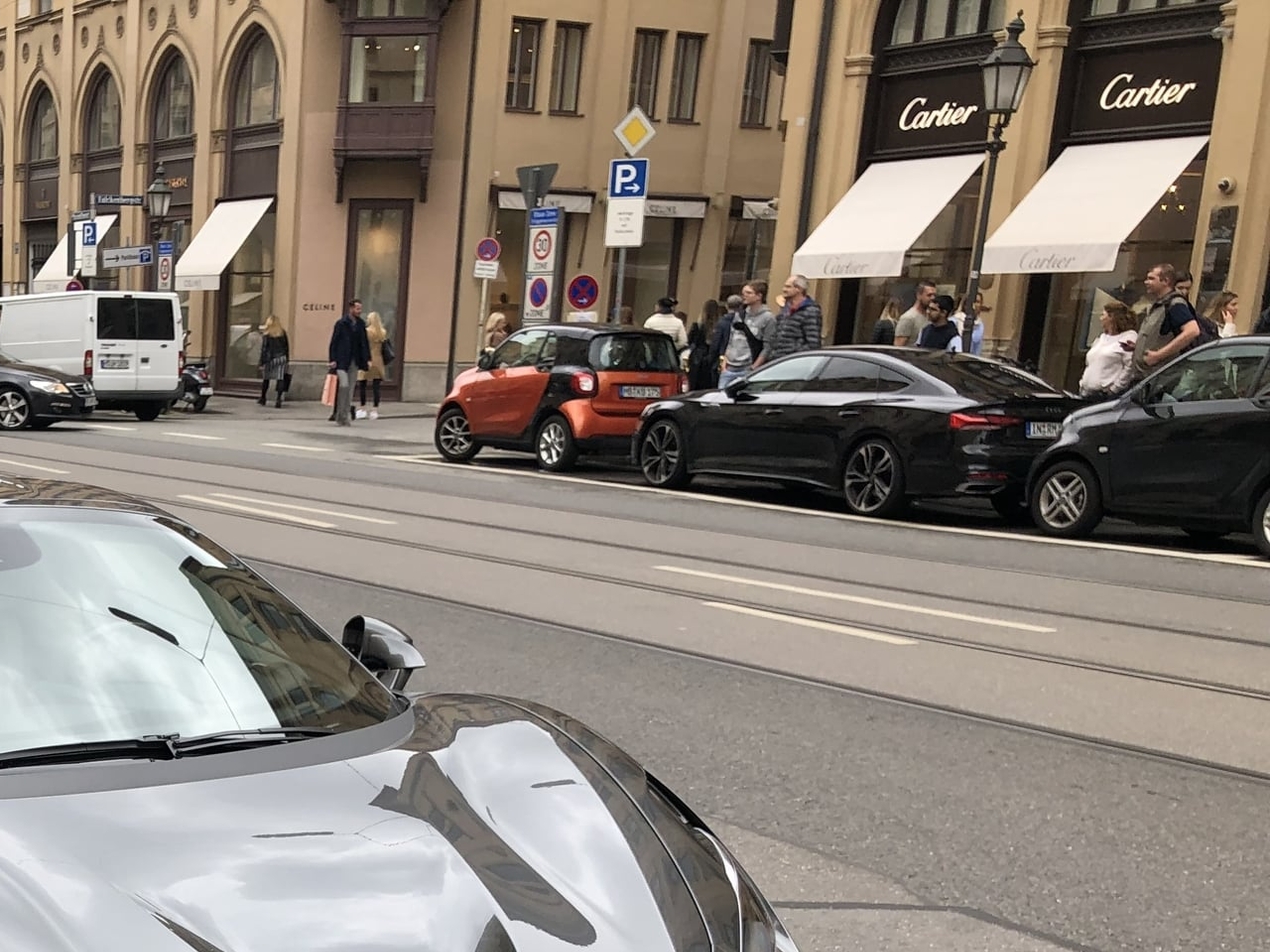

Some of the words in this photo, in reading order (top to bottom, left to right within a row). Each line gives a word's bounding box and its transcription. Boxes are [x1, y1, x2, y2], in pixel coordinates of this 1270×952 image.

[1099, 73, 1197, 110] Cartier
[898, 97, 978, 131] Cartier
[614, 164, 637, 193] P
[84, 225, 93, 243] P
[536, 238, 548, 252] 30
[823, 254, 869, 275] Cartier
[1018, 247, 1076, 270] Cartier
